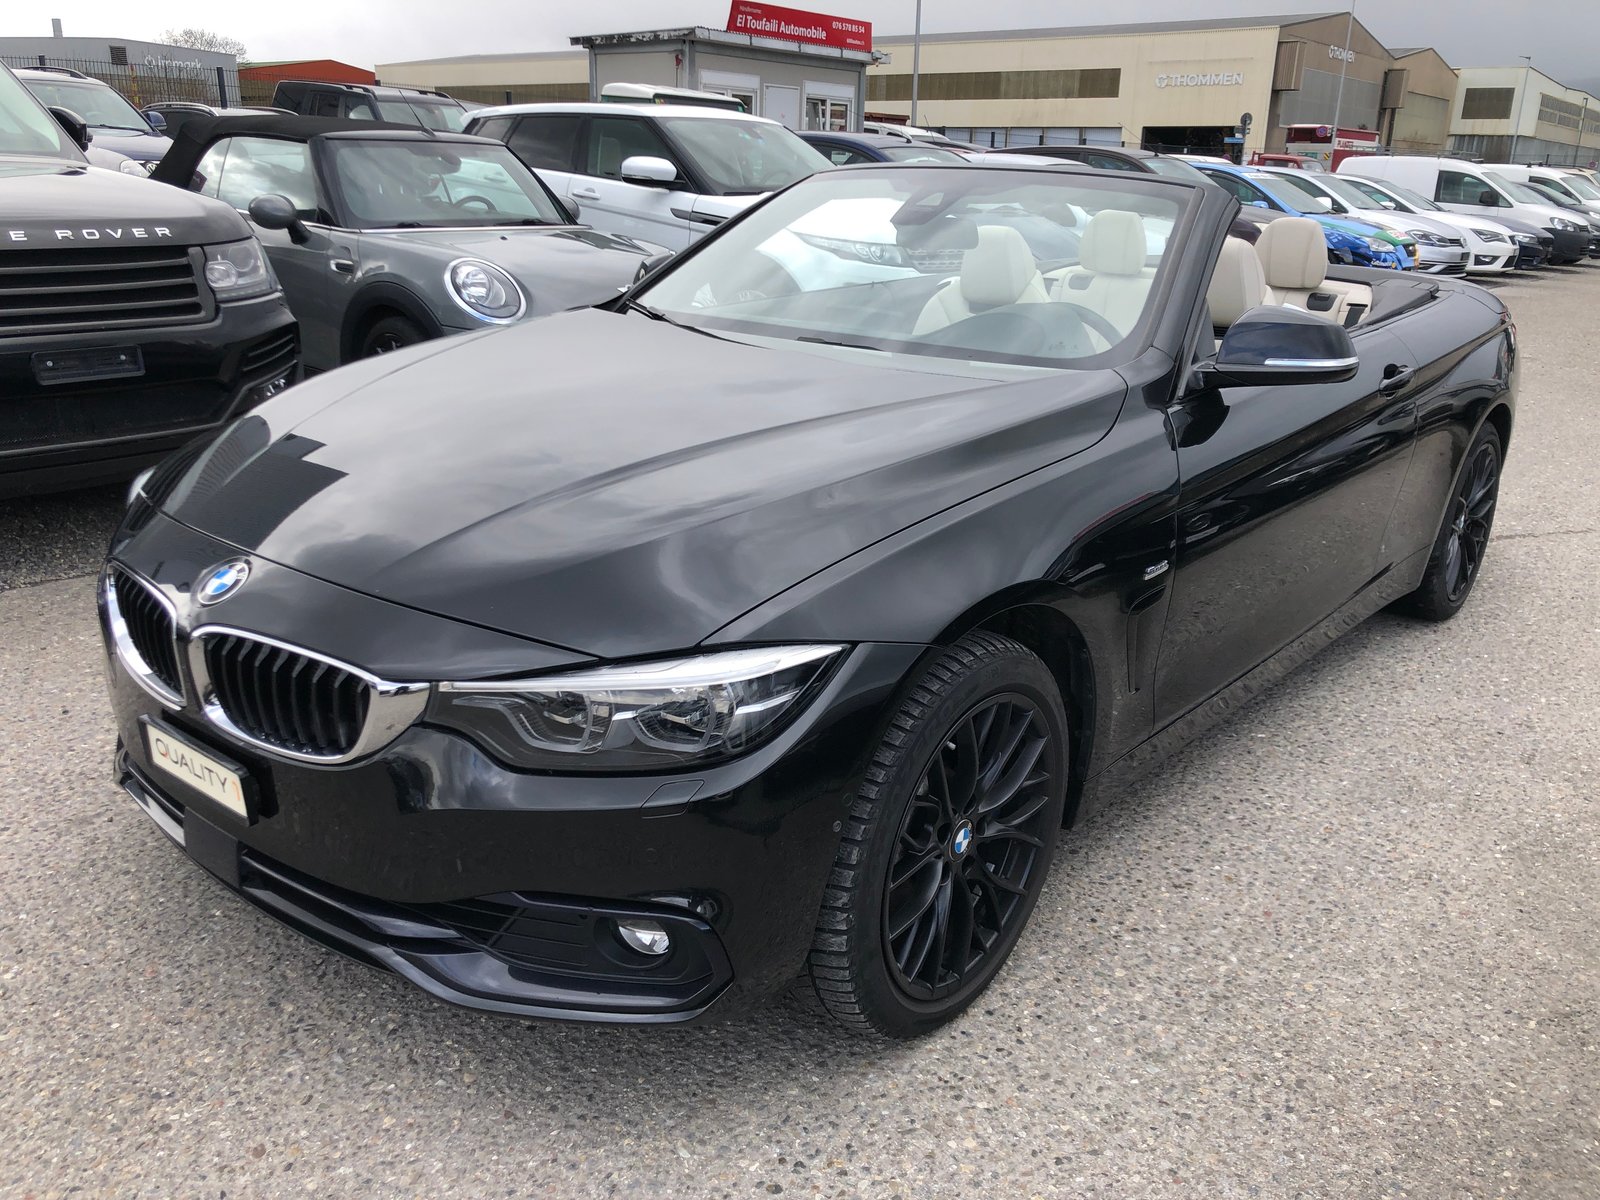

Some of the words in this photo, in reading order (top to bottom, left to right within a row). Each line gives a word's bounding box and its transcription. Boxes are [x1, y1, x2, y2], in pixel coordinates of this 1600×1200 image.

[736, 14, 746, 28] El
[746, 15, 779, 32] Toufaili
[779, 21, 827, 40] Automobile
[1171, 72, 1244, 87] THOMMEN
[55, 227, 173, 240] ROVER
[155, 737, 227, 793] QUALITY
